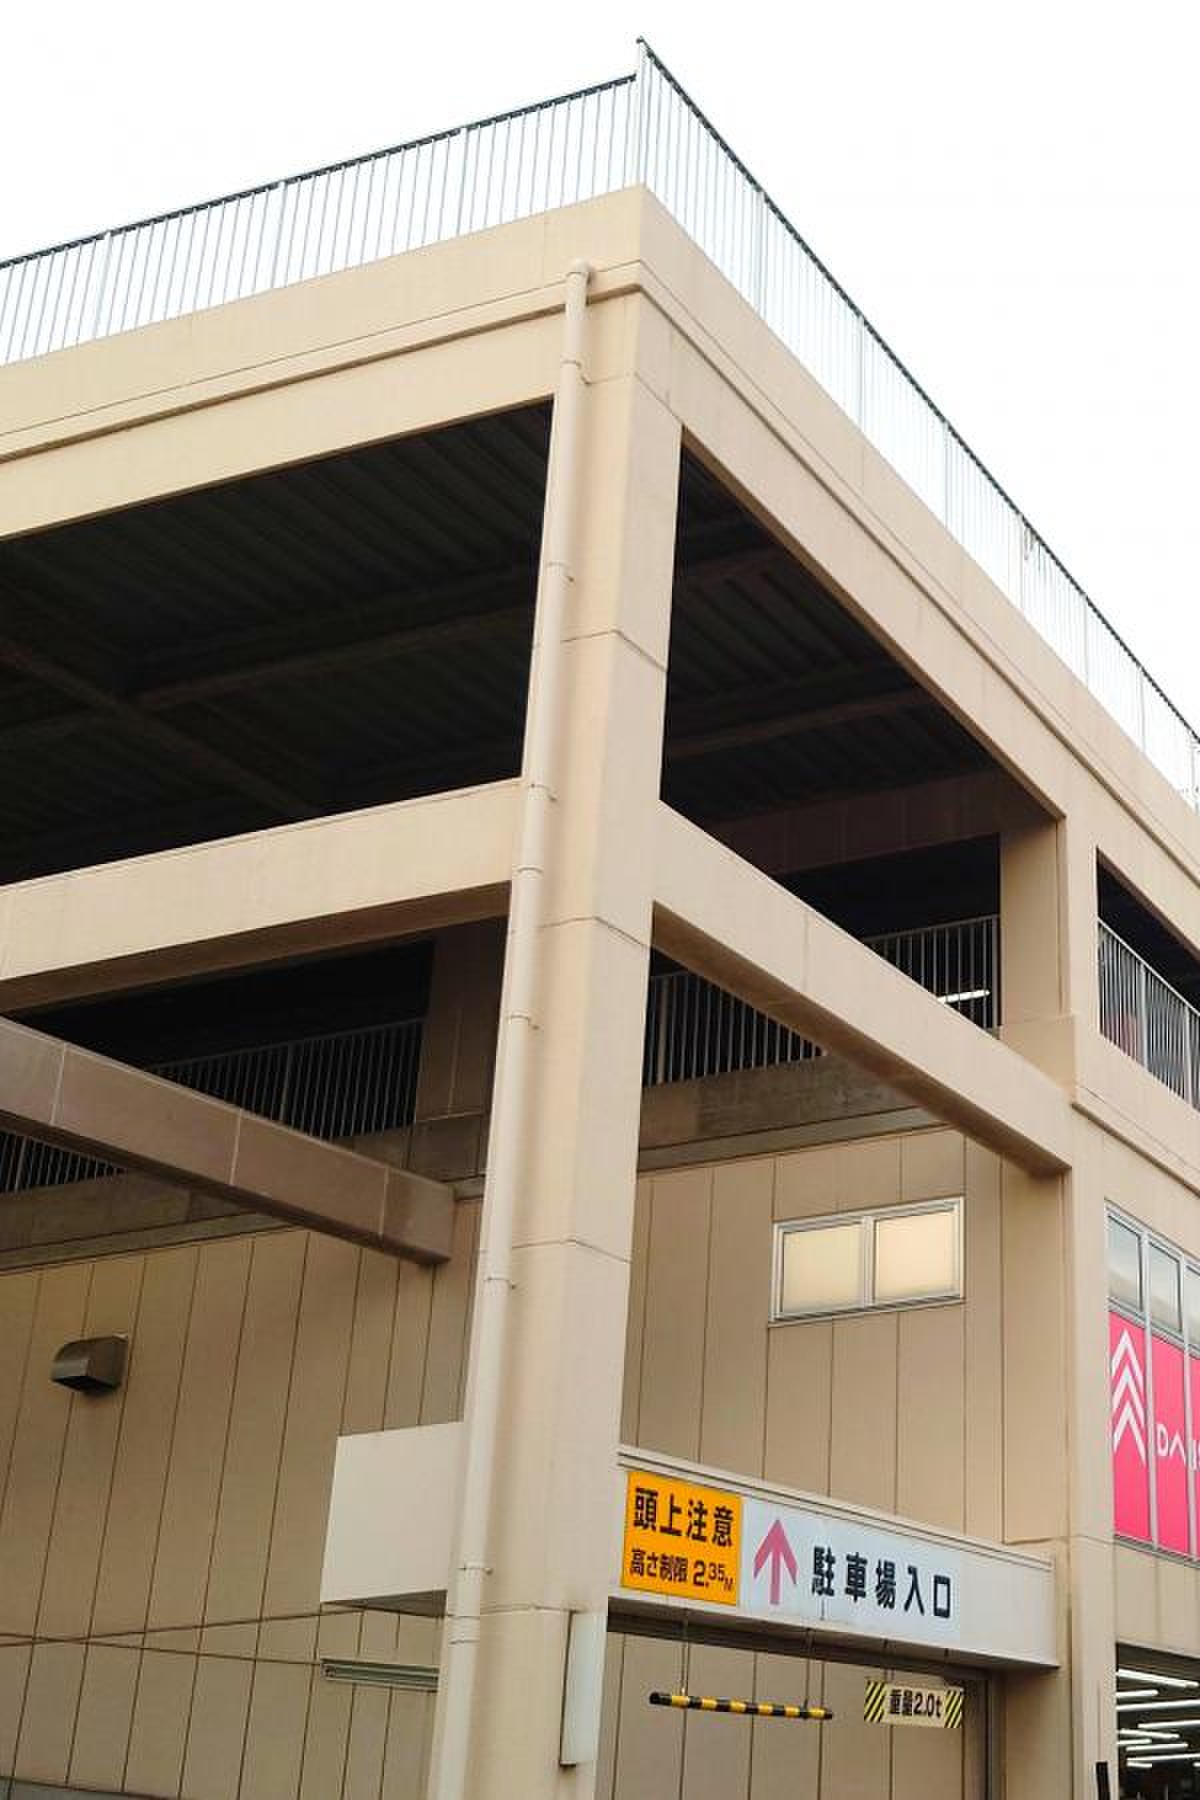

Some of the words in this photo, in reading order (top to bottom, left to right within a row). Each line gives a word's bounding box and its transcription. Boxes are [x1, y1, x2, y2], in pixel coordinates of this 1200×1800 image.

[633, 1486, 735, 1549] 頭上注意
[629, 1547, 690, 1584] 高さ制限
[811, 1545, 952, 1620] 駐車場入口
